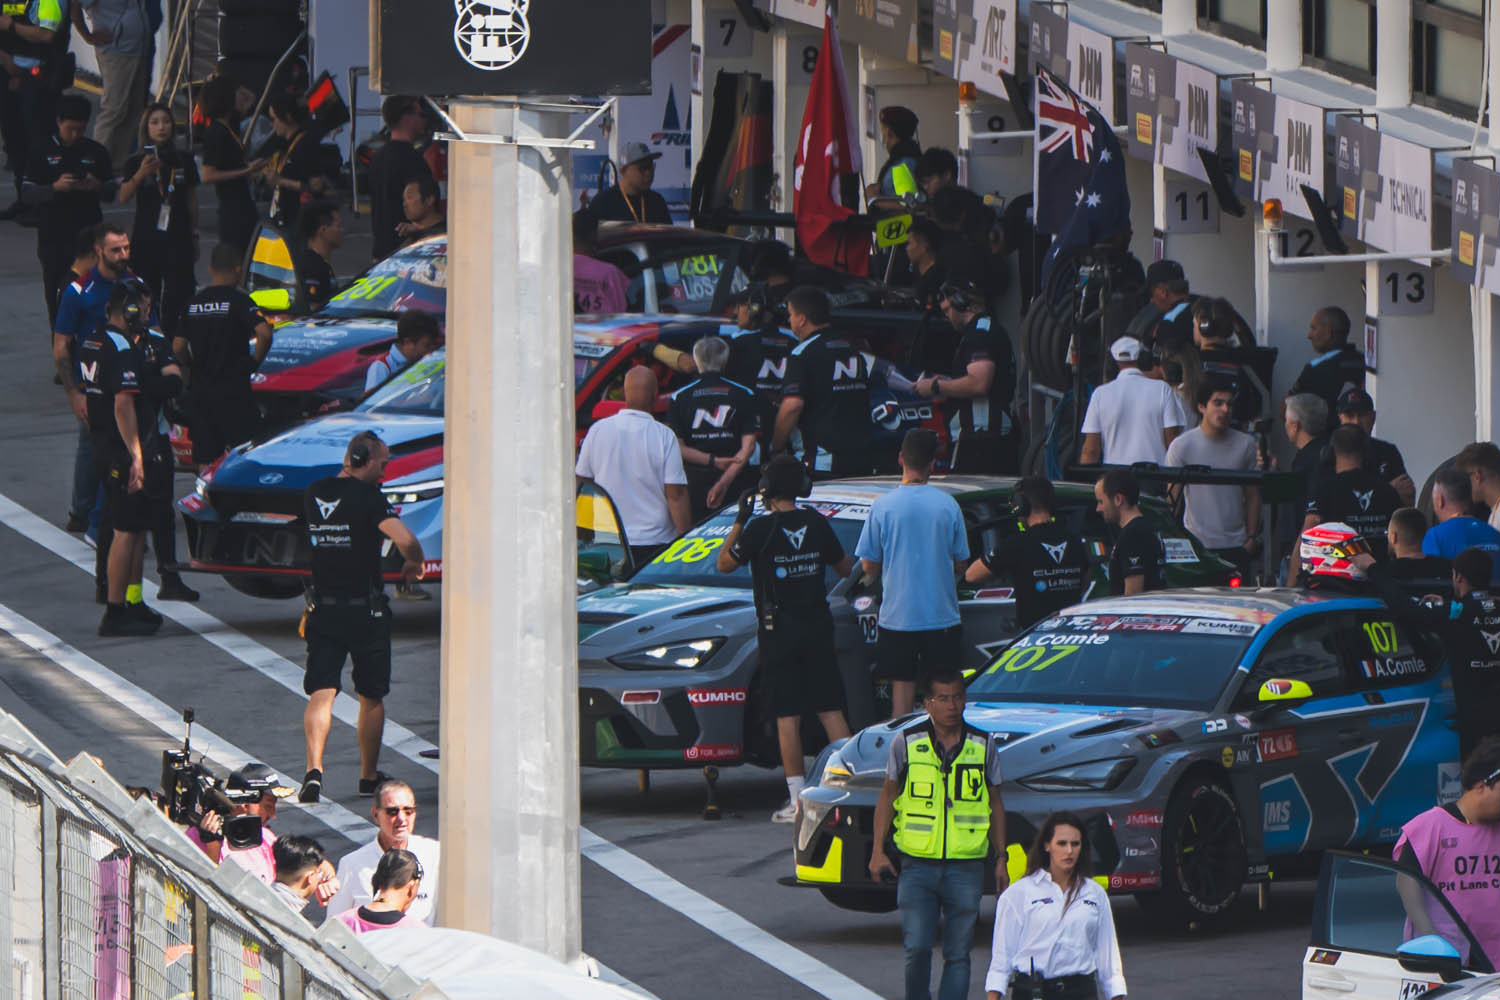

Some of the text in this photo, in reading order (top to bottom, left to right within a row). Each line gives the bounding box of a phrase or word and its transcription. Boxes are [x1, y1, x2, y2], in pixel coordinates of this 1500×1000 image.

[719, 19, 737, 46] 7
[1187, 83, 1209, 140] PHM
[1287, 118, 1312, 175] PHM
[1175, 192, 1209, 221] 11
[1389, 178, 1428, 222] TECHNICAL
[1386, 271, 1425, 304] 13
[653, 538, 724, 563] 108
[1362, 621, 1399, 654] 107
[985, 645, 1081, 675] 107
[687, 692, 746, 703] KUMHO
[1460, 879, 1489, 891] Lane
